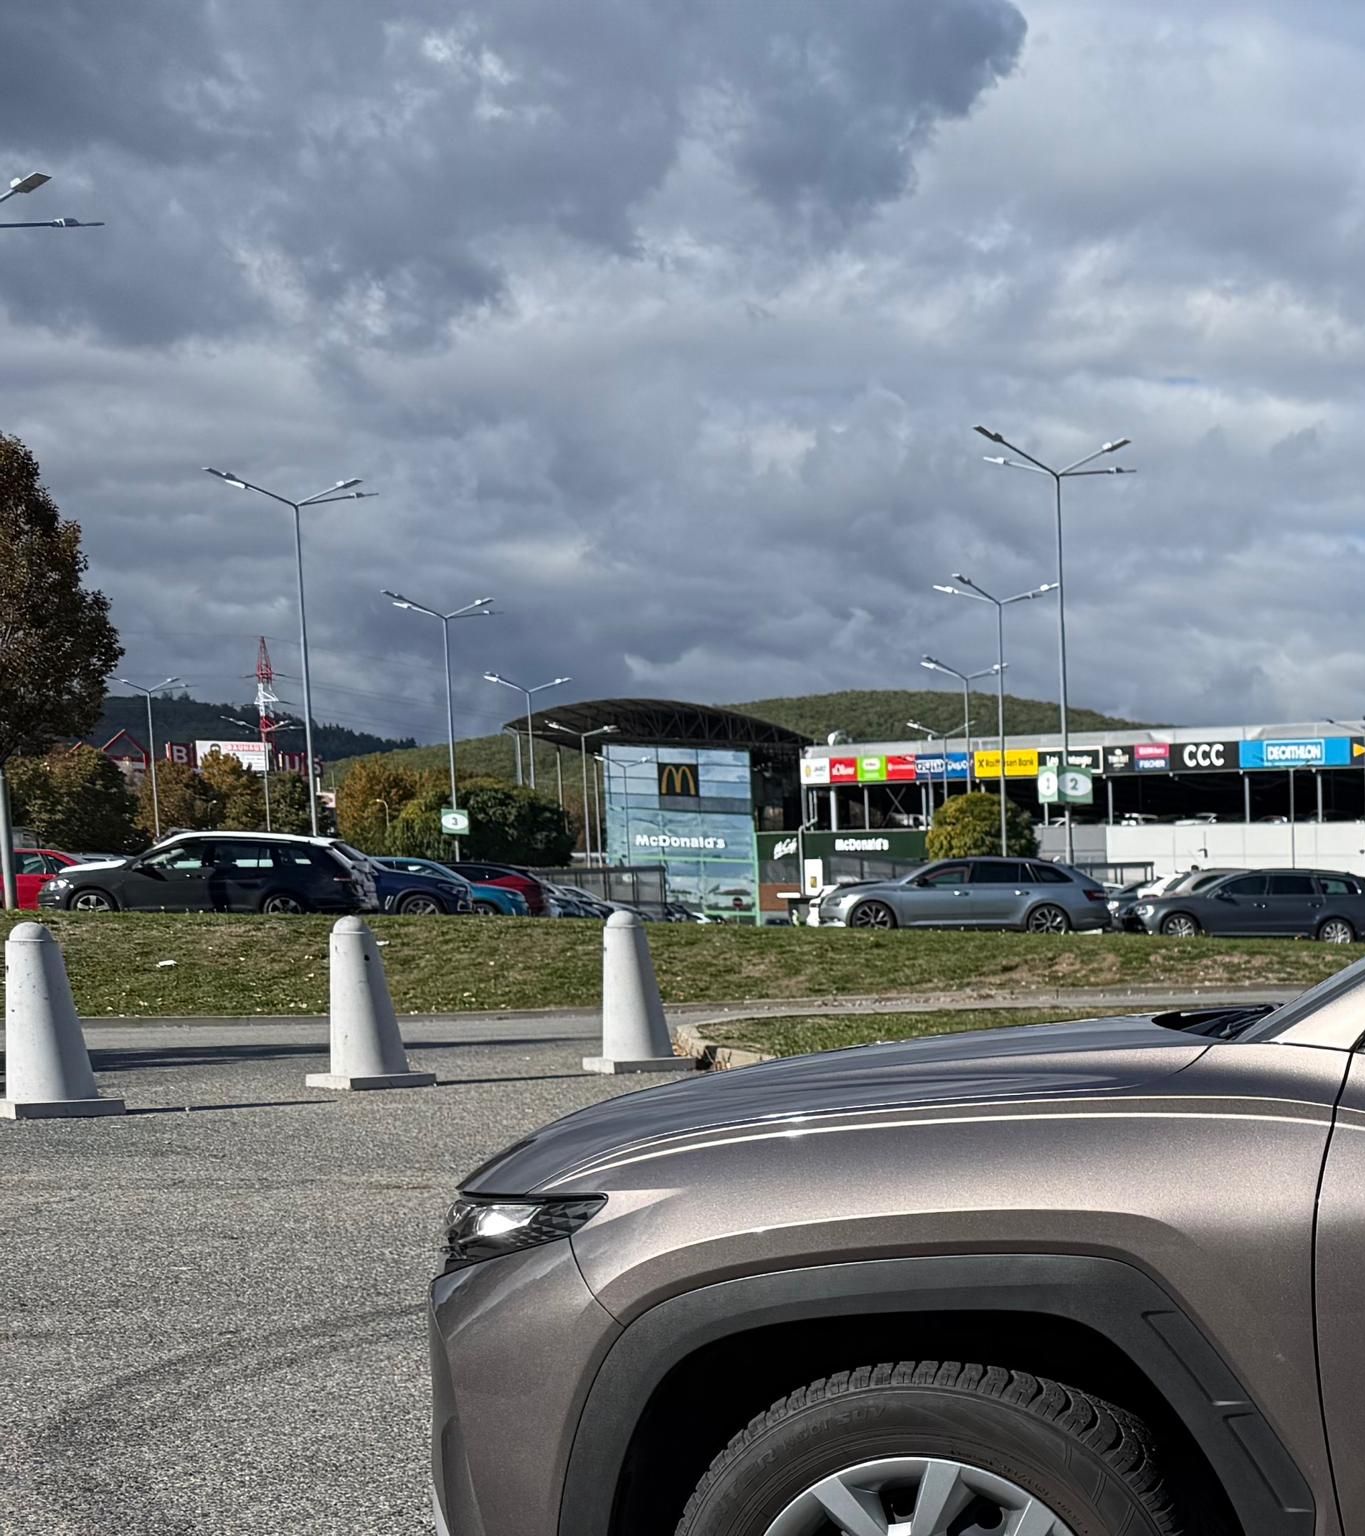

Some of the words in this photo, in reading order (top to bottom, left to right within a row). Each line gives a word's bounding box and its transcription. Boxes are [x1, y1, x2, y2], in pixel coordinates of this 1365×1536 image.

[1183, 744, 1225, 767] CCC
[1267, 744, 1321, 760] DECATHLON
[1070, 777, 1079, 791] 2
[451, 817, 459, 826] 3
[635, 834, 726, 849] McDonald's
[834, 838, 889, 851] McDonald's
